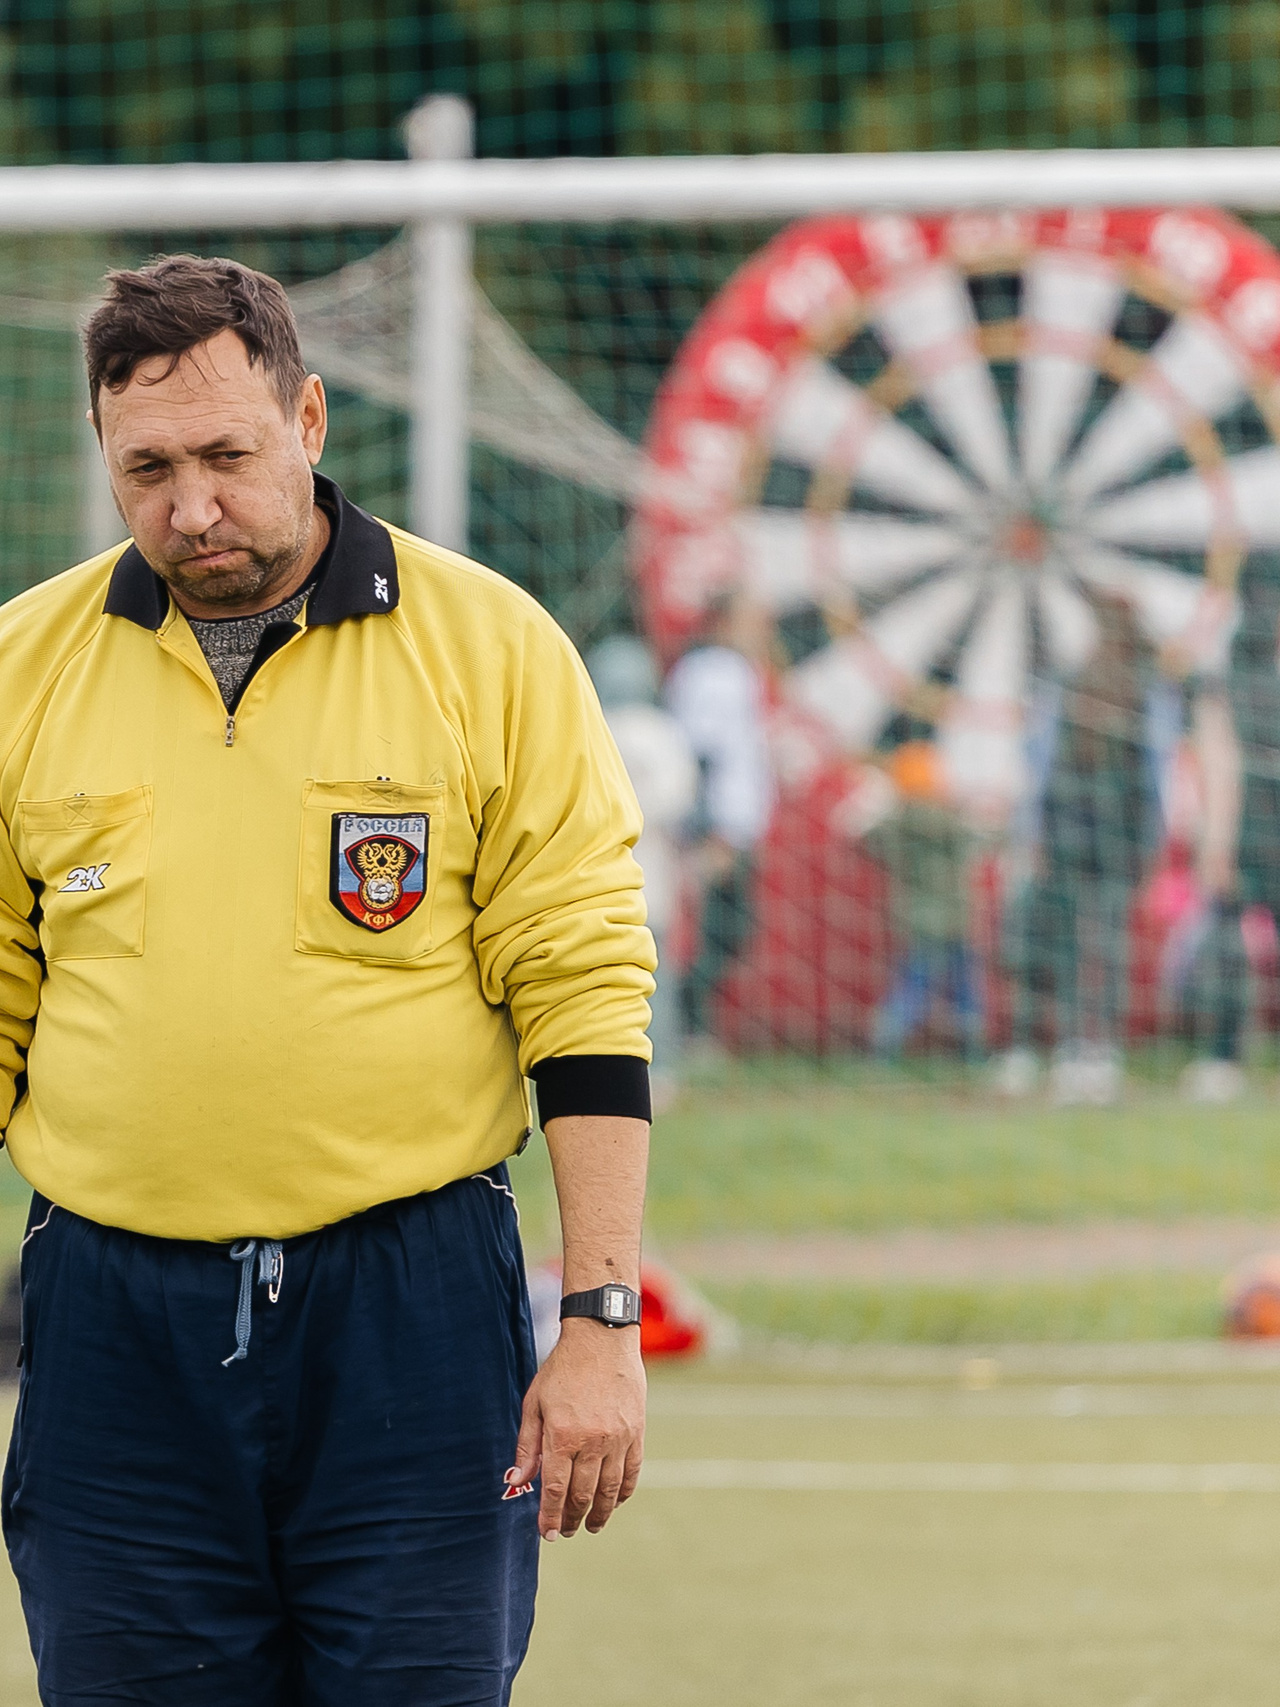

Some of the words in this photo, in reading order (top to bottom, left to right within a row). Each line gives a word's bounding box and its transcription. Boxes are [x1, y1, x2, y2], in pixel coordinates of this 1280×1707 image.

[374, 573, 389, 604] 2K
[344, 819, 423, 833] РОССИЯ
[57, 863, 111, 892] 2K
[362, 912, 395, 926] КФА
